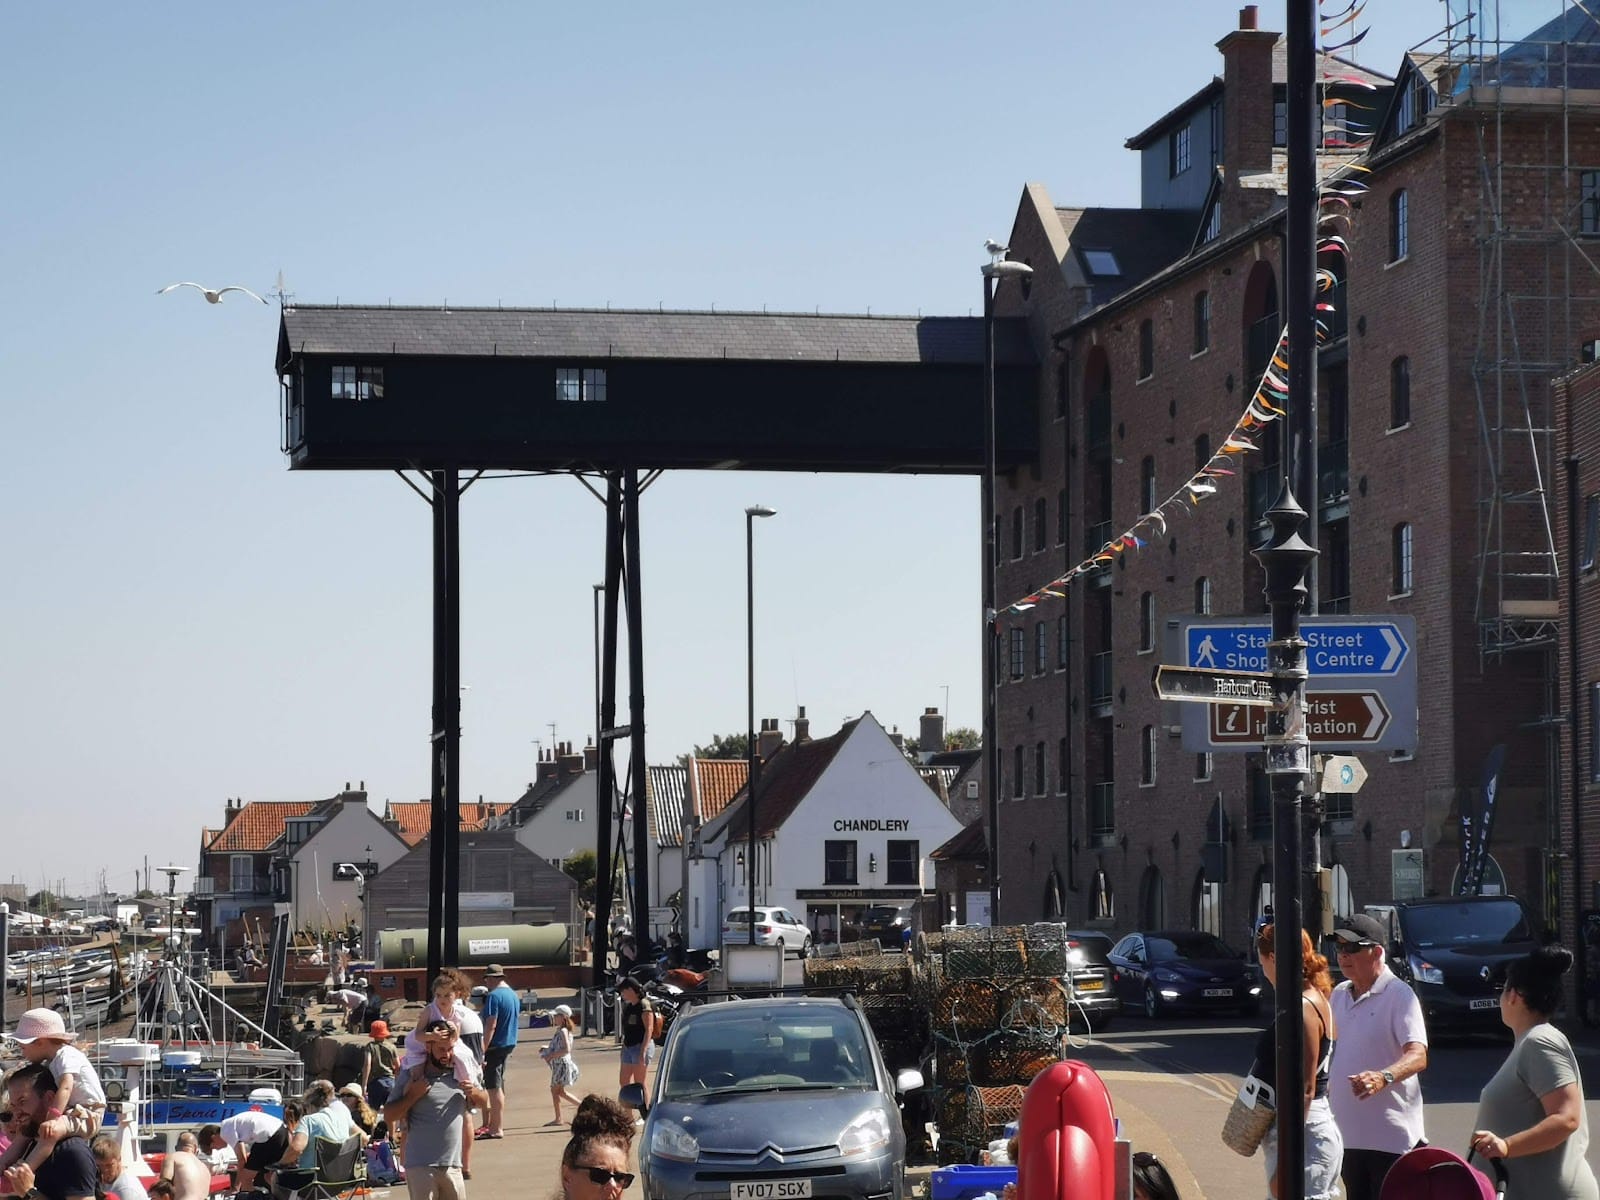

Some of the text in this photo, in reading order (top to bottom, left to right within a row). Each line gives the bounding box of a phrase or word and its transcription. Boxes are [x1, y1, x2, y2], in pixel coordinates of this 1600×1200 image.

[1308, 632, 1362, 648] Street
[1315, 651, 1374, 667] Centre
[1214, 677, 1250, 697] Harbour
[833, 819, 910, 832] CHANDLERY
[736, 1182, 806, 1198] FV07 SGX
